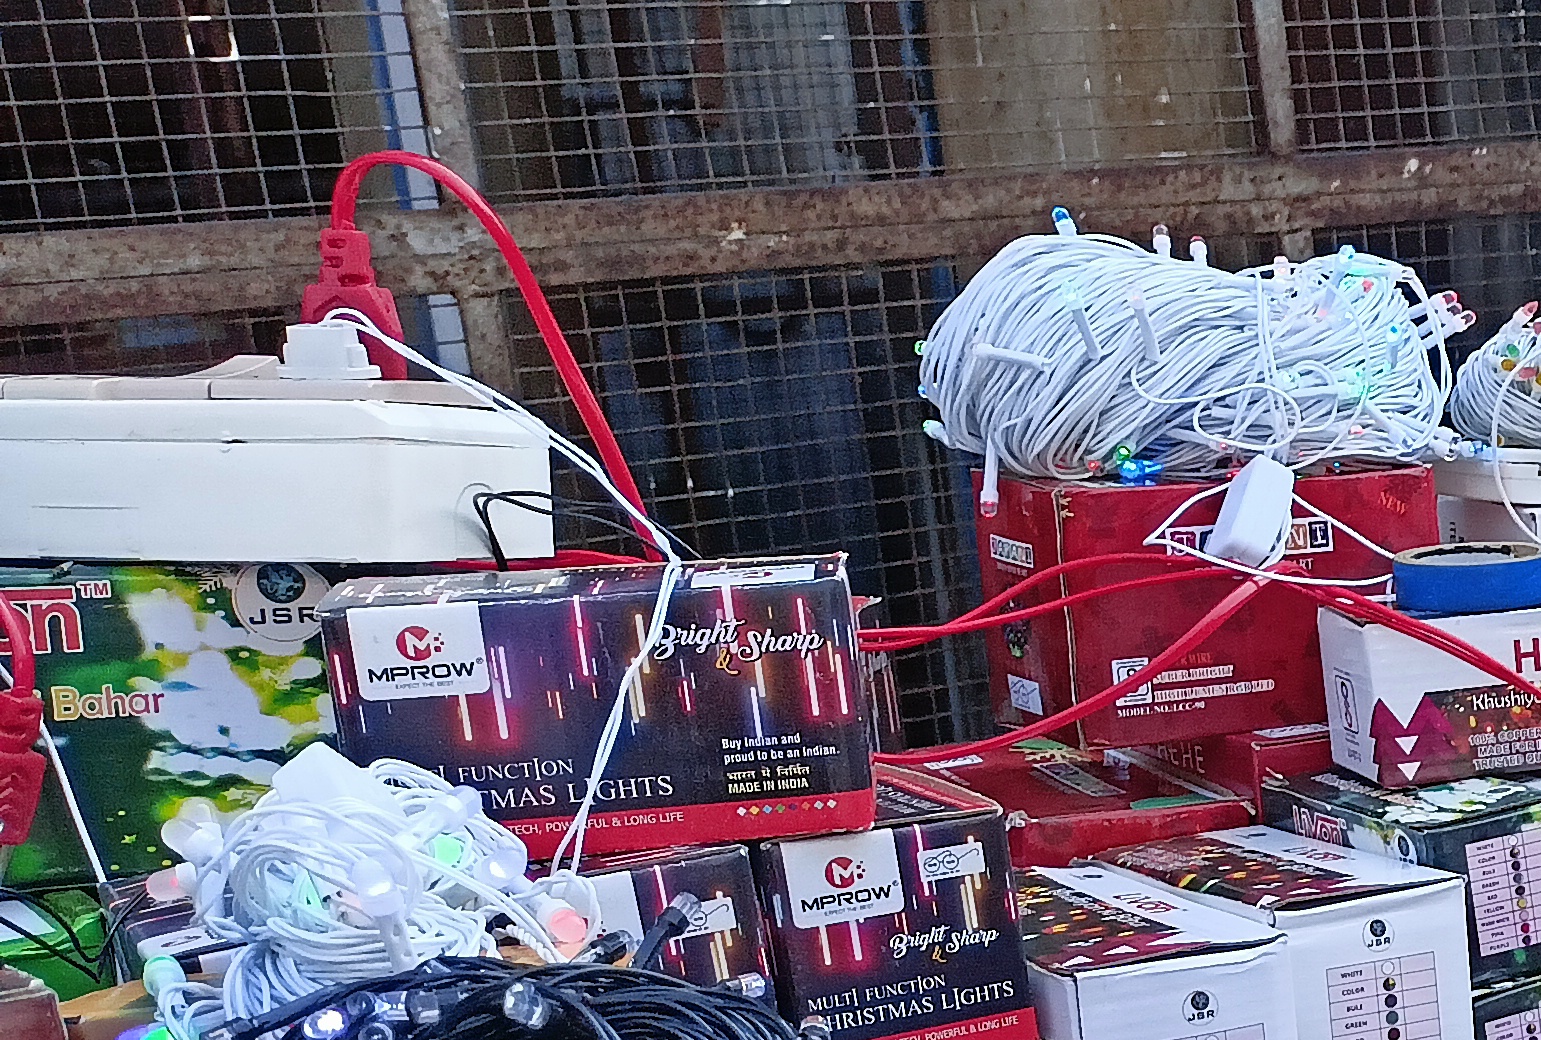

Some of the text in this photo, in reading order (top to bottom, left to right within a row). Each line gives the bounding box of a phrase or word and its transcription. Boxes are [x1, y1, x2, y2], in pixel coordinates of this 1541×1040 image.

[76, 580, 112, 599] TM
[652, 618, 746, 660] Bright
[738, 628, 828, 662] Sharp
[51, 683, 166, 721] Bahar
[721, 733, 801, 751] Buy Indian and
[1477, 744, 1510, 758] MADE
[1511, 742, 1535, 755] FOR
[724, 753, 755, 767] proud
[757, 752, 768, 761] to
[770, 750, 784, 760] be
[786, 750, 800, 759] an
[1472, 755, 1524, 771] TRUSTED
[458, 756, 575, 784] FUNCTION
[728, 777, 809, 795] MADE IN INDIA
[611, 811, 685, 828] & LONG LIFE
[1292, 804, 1343, 846] LiVon
[889, 924, 950, 959] Bright
[945, 927, 1000, 954] Sharp
[807, 974, 948, 1013] MULTI FUNCTION
[825, 980, 1016, 1032] HRISTMAS LIGHTS
[977, 1018, 1000, 1031] LONG
[1000, 1014, 1020, 1026] LIFE
